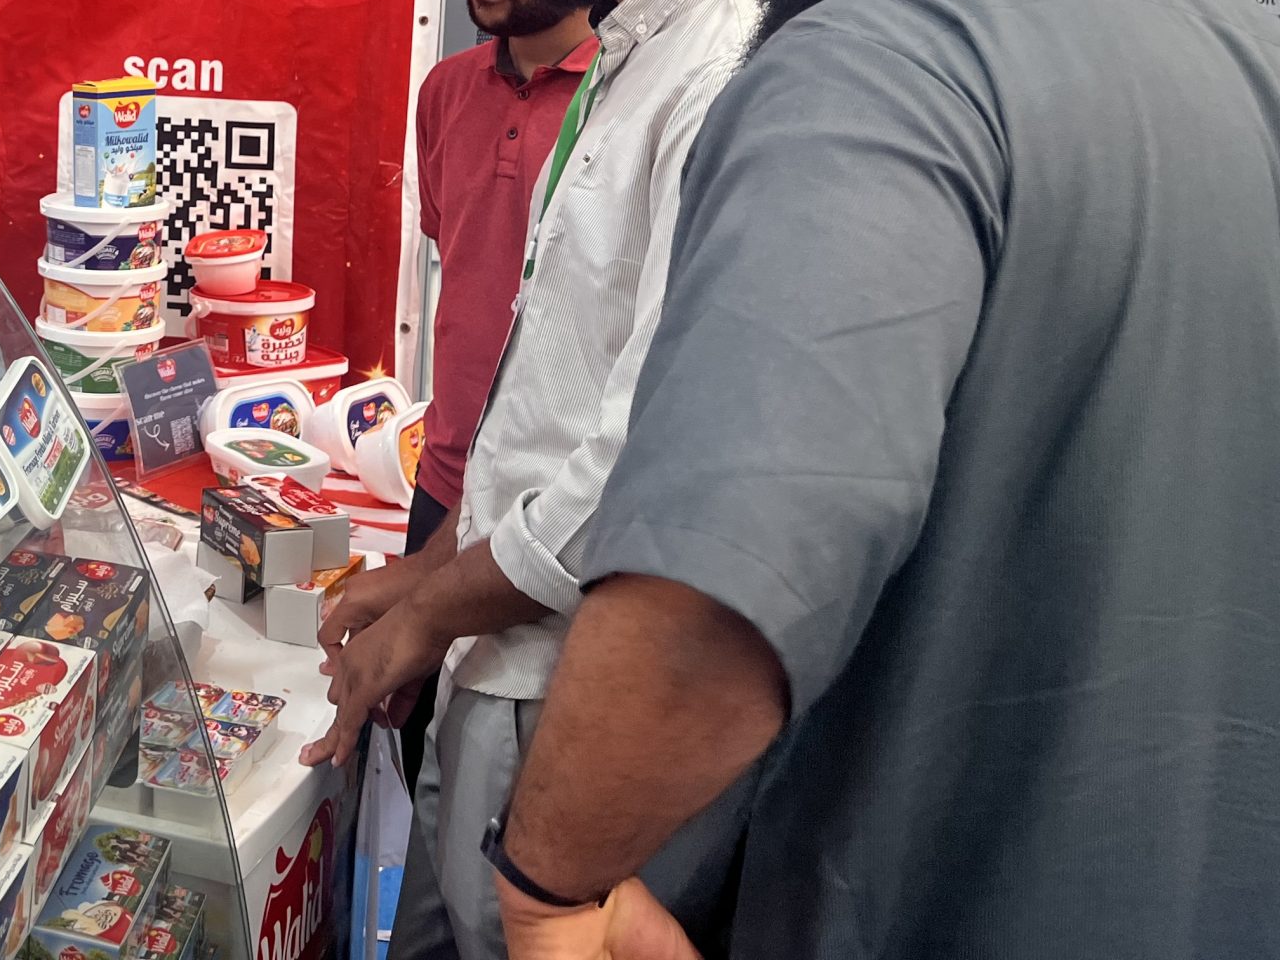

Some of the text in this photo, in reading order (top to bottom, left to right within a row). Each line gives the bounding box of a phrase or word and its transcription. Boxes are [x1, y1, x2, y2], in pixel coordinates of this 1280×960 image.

[122, 55, 224, 93] scan
[114, 110, 137, 123] Walid
[105, 133, 149, 147] Milkowalid
[21, 407, 38, 435] Walid
[22, 448, 39, 477] Fromage
[59, 850, 101, 897] Fromage
[115, 875, 136, 897] Walid
[259, 855, 324, 960] Walid
[151, 931, 172, 953] Walid
